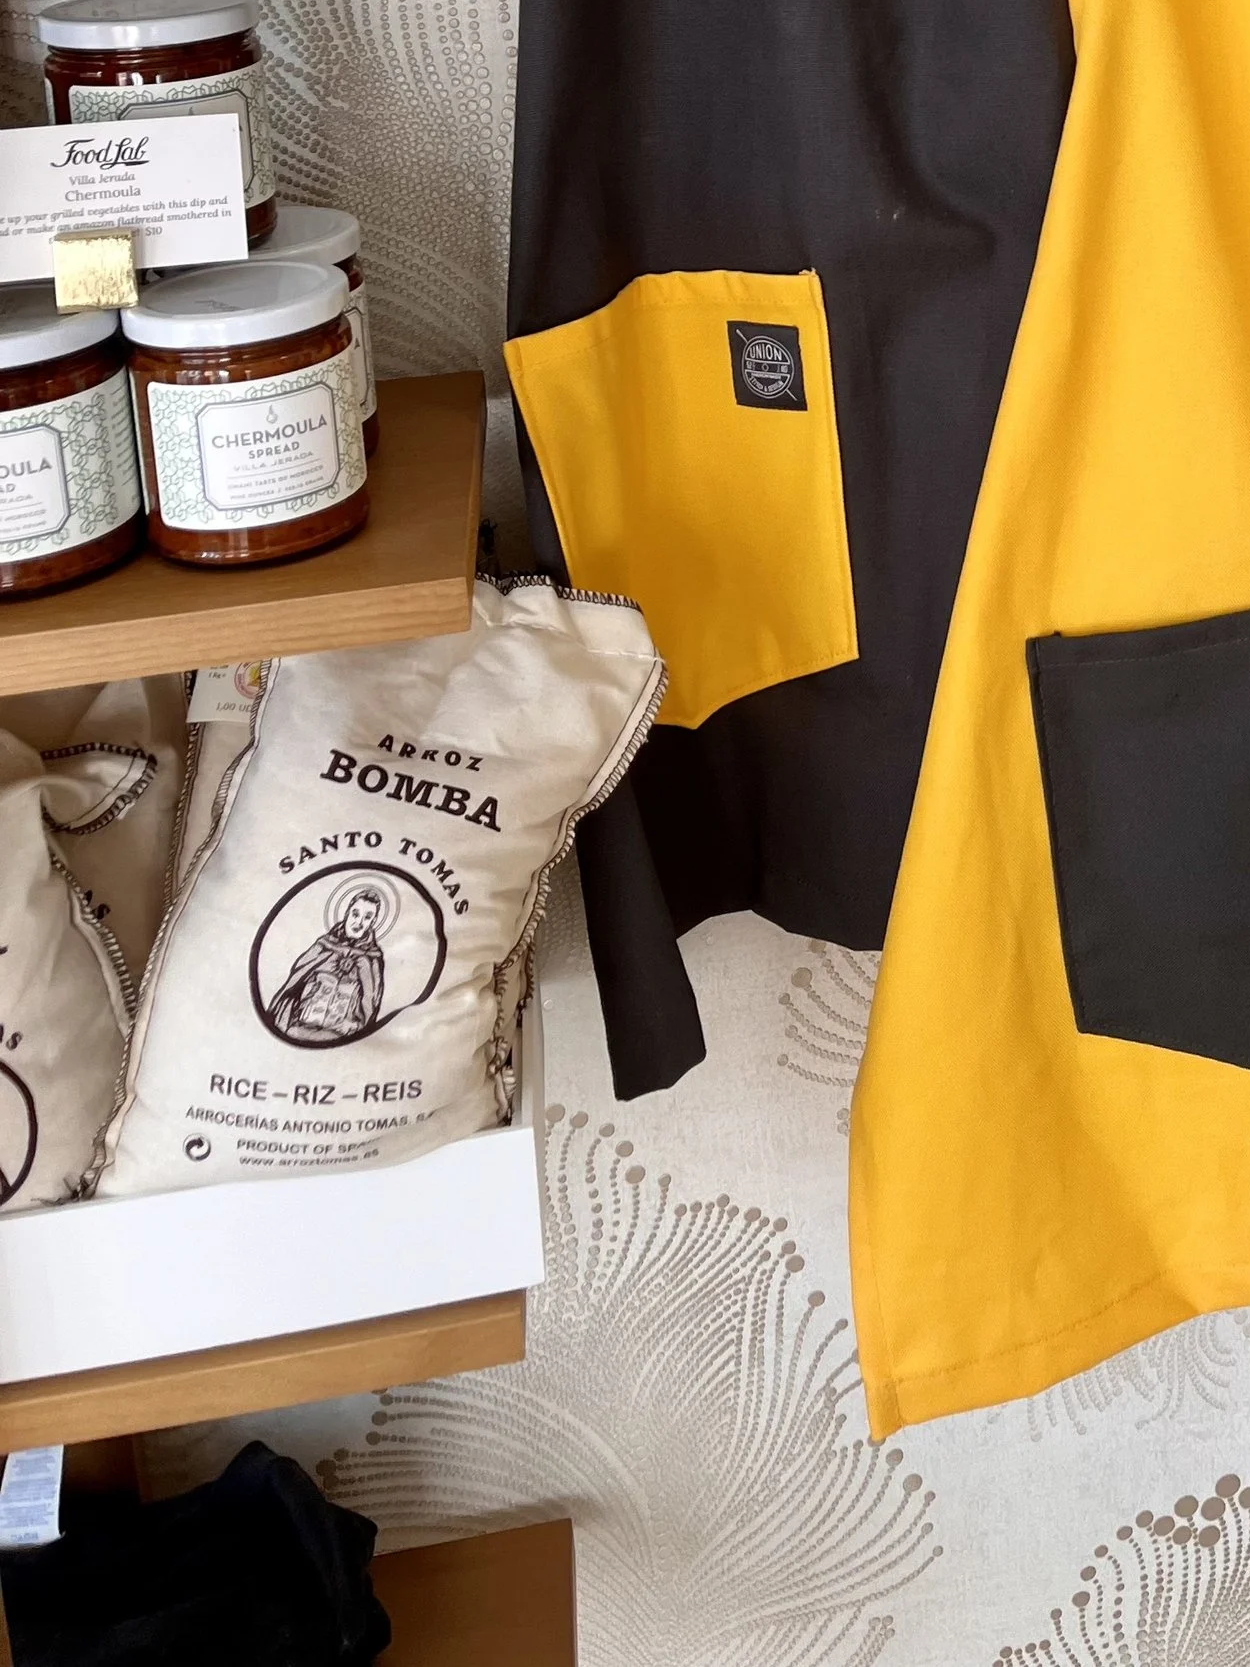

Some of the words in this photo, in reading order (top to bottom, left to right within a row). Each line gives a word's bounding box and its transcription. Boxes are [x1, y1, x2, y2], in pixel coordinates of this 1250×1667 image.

[69, 172, 95, 185] Villa
[98, 171, 136, 184] Jerada
[64, 185, 142, 203] Chermoula
[7, 215, 22, 226] up
[24, 213, 48, 224] your
[50, 208, 85, 222] grilled
[87, 203, 140, 217] vegetables
[142, 201, 166, 212] with
[168, 198, 189, 209] this
[190, 196, 207, 208] dip
[209, 195, 228, 205] and
[12, 228, 24, 236] or
[27, 223, 54, 234] make
[73, 219, 115, 230] amazon
[117, 213, 164, 228] flatbread
[167, 209, 220, 222] smothered
[221, 208, 232, 217] in
[145, 225, 163, 236] $10
[749, 343, 782, 361] UNION
[211, 414, 327, 449] CHERMOULA
[234, 462, 267, 472] VILLA
[271, 450, 314, 467] JERADA
[249, 441, 300, 460] SPREAD
[320, 749, 501, 832] BOMBA
[279, 831, 383, 874] SANTO
[400, 838, 470, 915] TOMAS
[210, 1074, 267, 1101] RICE
[293, 1085, 336, 1105] RIZ
[363, 1080, 424, 1103] REIS
[186, 1105, 279, 1132] ARROCERÍAS
[282, 1120, 352, 1134] ANTONIO
[236, 1138, 307, 1155] PRODUCT
[313, 1143, 333, 1155] OF
